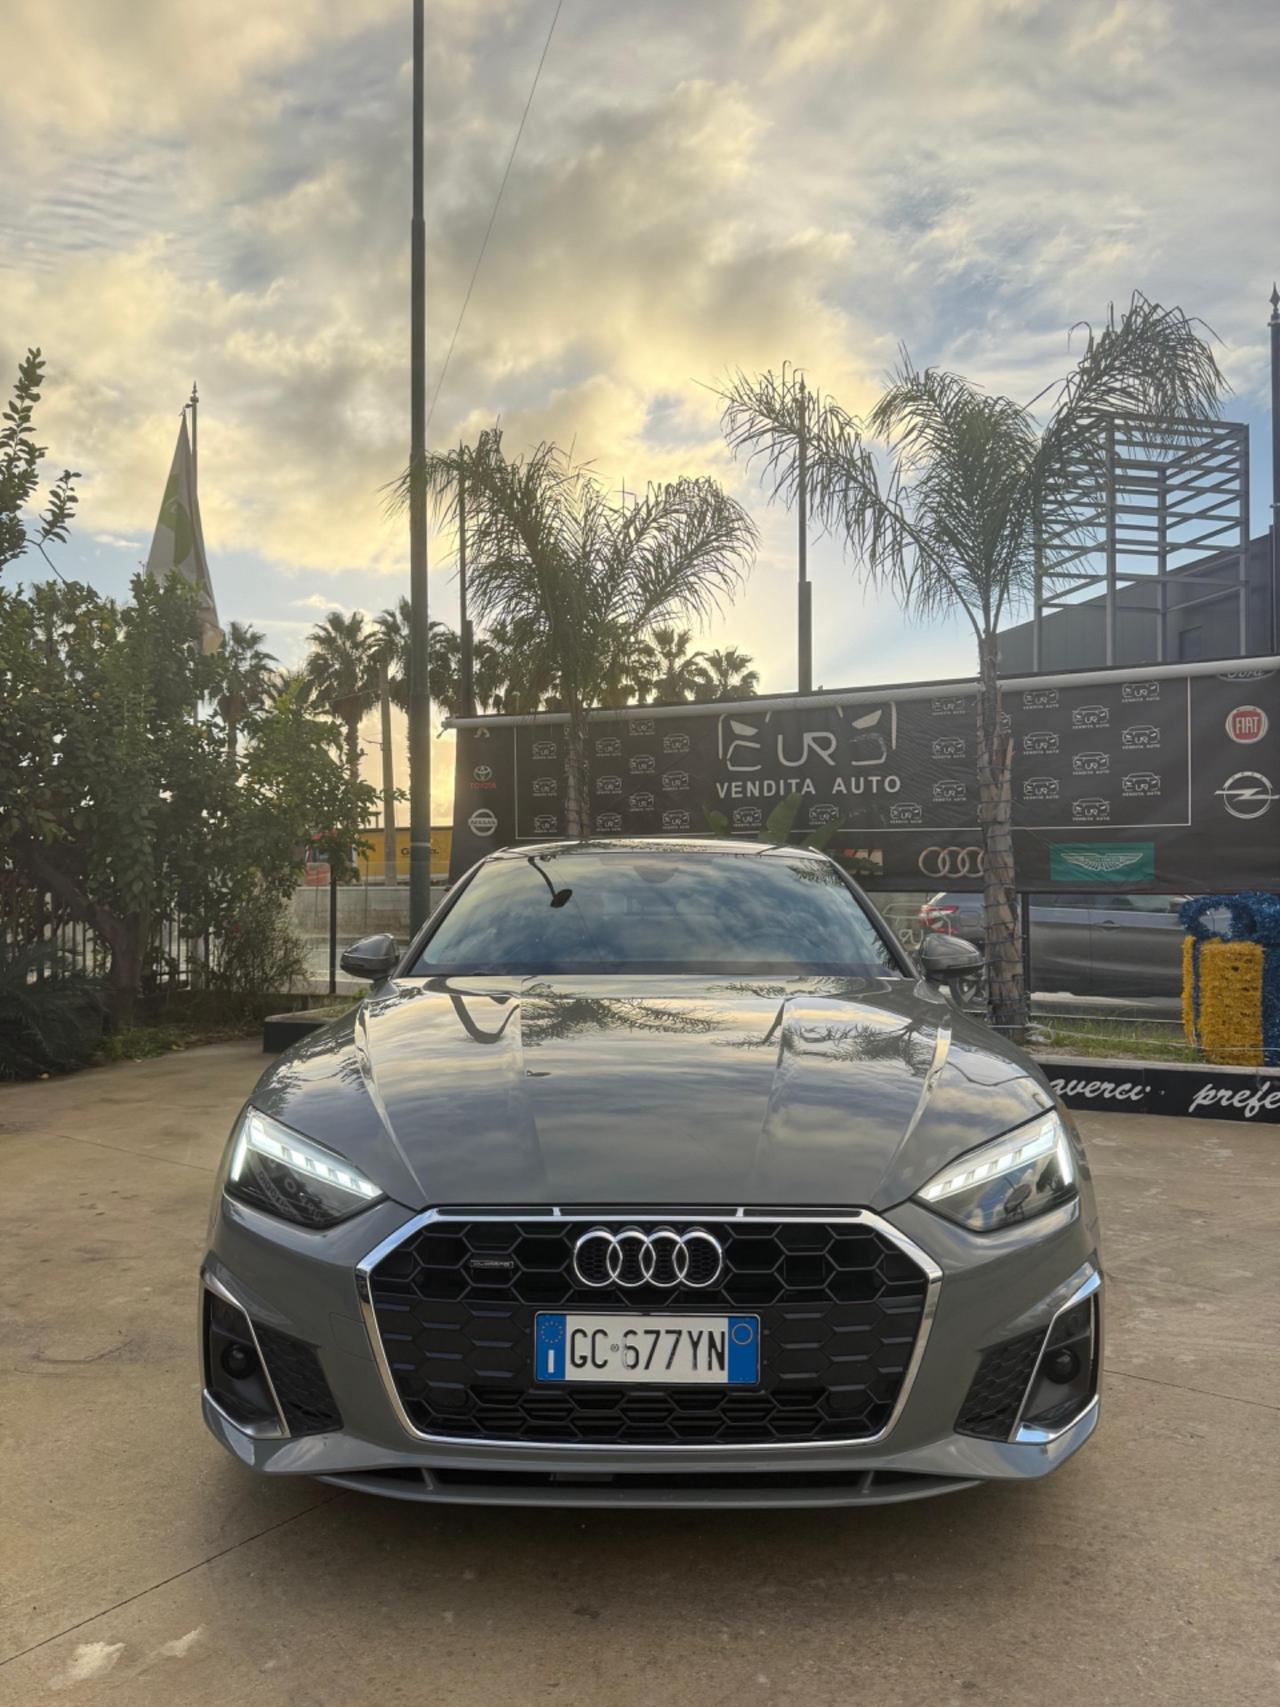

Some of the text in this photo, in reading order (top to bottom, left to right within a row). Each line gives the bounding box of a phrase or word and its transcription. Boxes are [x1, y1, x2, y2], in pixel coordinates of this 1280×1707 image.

[1235, 716, 1260, 735] FIAT
[715, 775, 901, 799] VENDITA AUTO
[569, 1328, 726, 1372] GC 677YN
